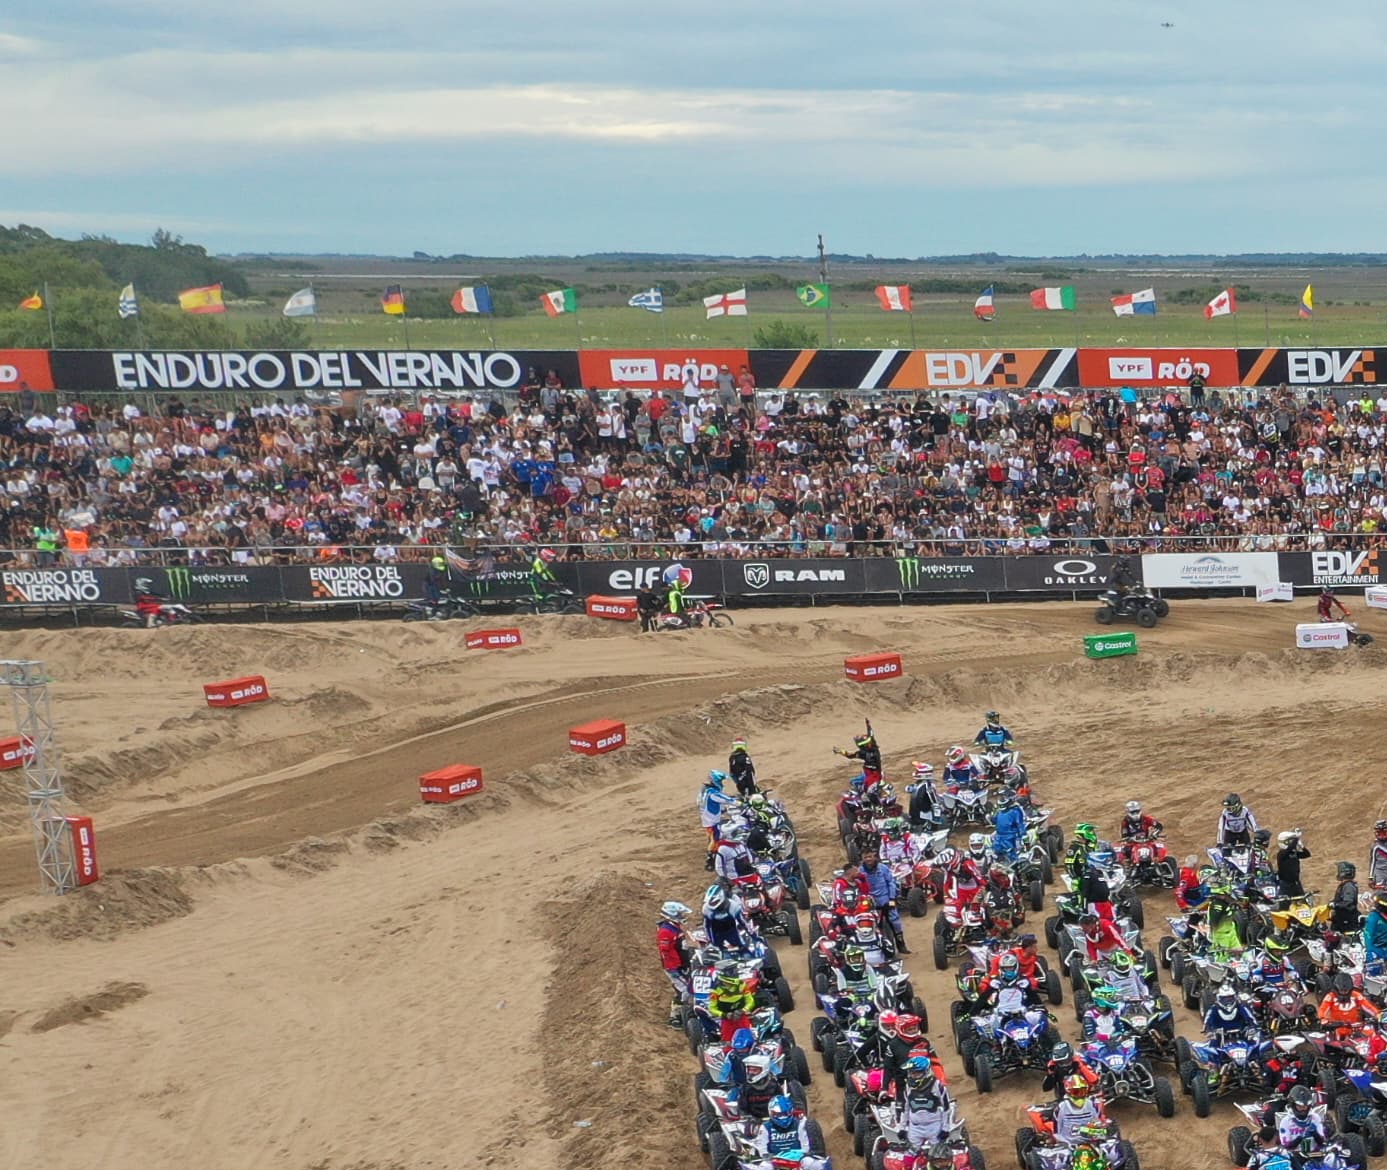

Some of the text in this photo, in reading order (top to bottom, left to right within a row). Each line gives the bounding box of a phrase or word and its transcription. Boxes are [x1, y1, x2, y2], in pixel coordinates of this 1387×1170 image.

[113, 352, 520, 388] ENDURO DEL VERANO
[619, 358, 717, 381] YPF RÖD
[1117, 365, 1144, 373] YPF
[310, 567, 401, 580] ENDURO DEL
[775, 569, 845, 581] RAM
[922, 564, 974, 574] MONSTER
[3, 571, 98, 585] ENDURO DEL
[192, 574, 248, 583] MONSTER
[609, 567, 660, 589] elf
[1044, 576, 1107, 584] OAKLEY
[1313, 575, 1378, 584] ENTERTAINMENT
[17, 584, 99, 601] VERANO
[322, 579, 403, 597] VERANO
[1313, 633, 1340, 641] Castrol
[1105, 640, 1131, 649] Castrol
[694, 977, 710, 992] 22
[770, 1132, 796, 1141] SHIFT
